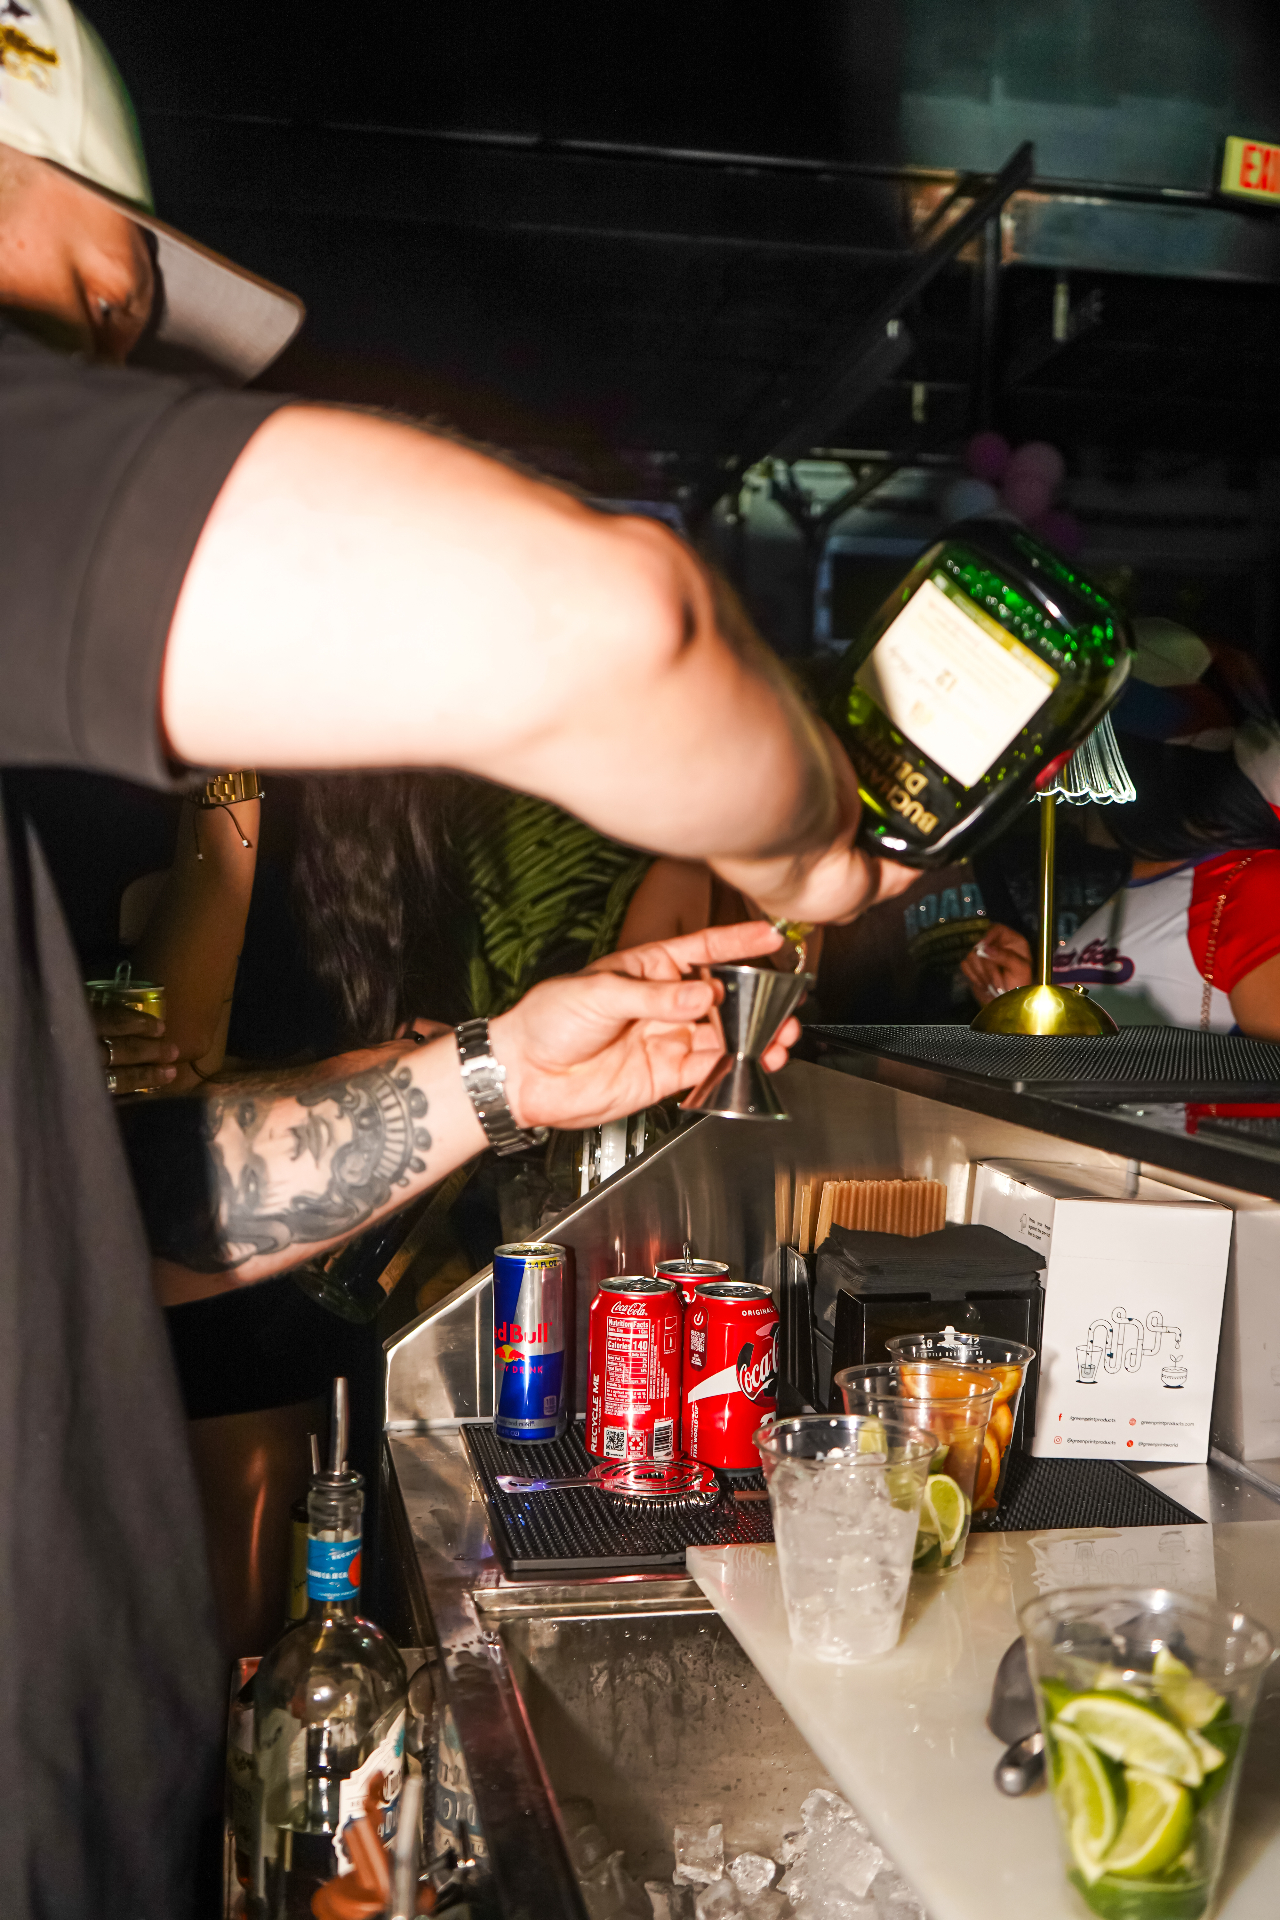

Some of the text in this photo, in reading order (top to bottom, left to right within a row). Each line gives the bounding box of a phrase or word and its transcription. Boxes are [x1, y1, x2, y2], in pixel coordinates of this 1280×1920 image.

[741, 1307, 774, 1317] ORIGINAL
[608, 1318, 649, 1329] Nutrition Facts
[509, 1323, 548, 1344] Bull
[633, 1340, 648, 1351] 140
[512, 1365, 543, 1374] DRNK
[592, 1373, 600, 1394] ME
[590, 1395, 599, 1453] RECYCLE
